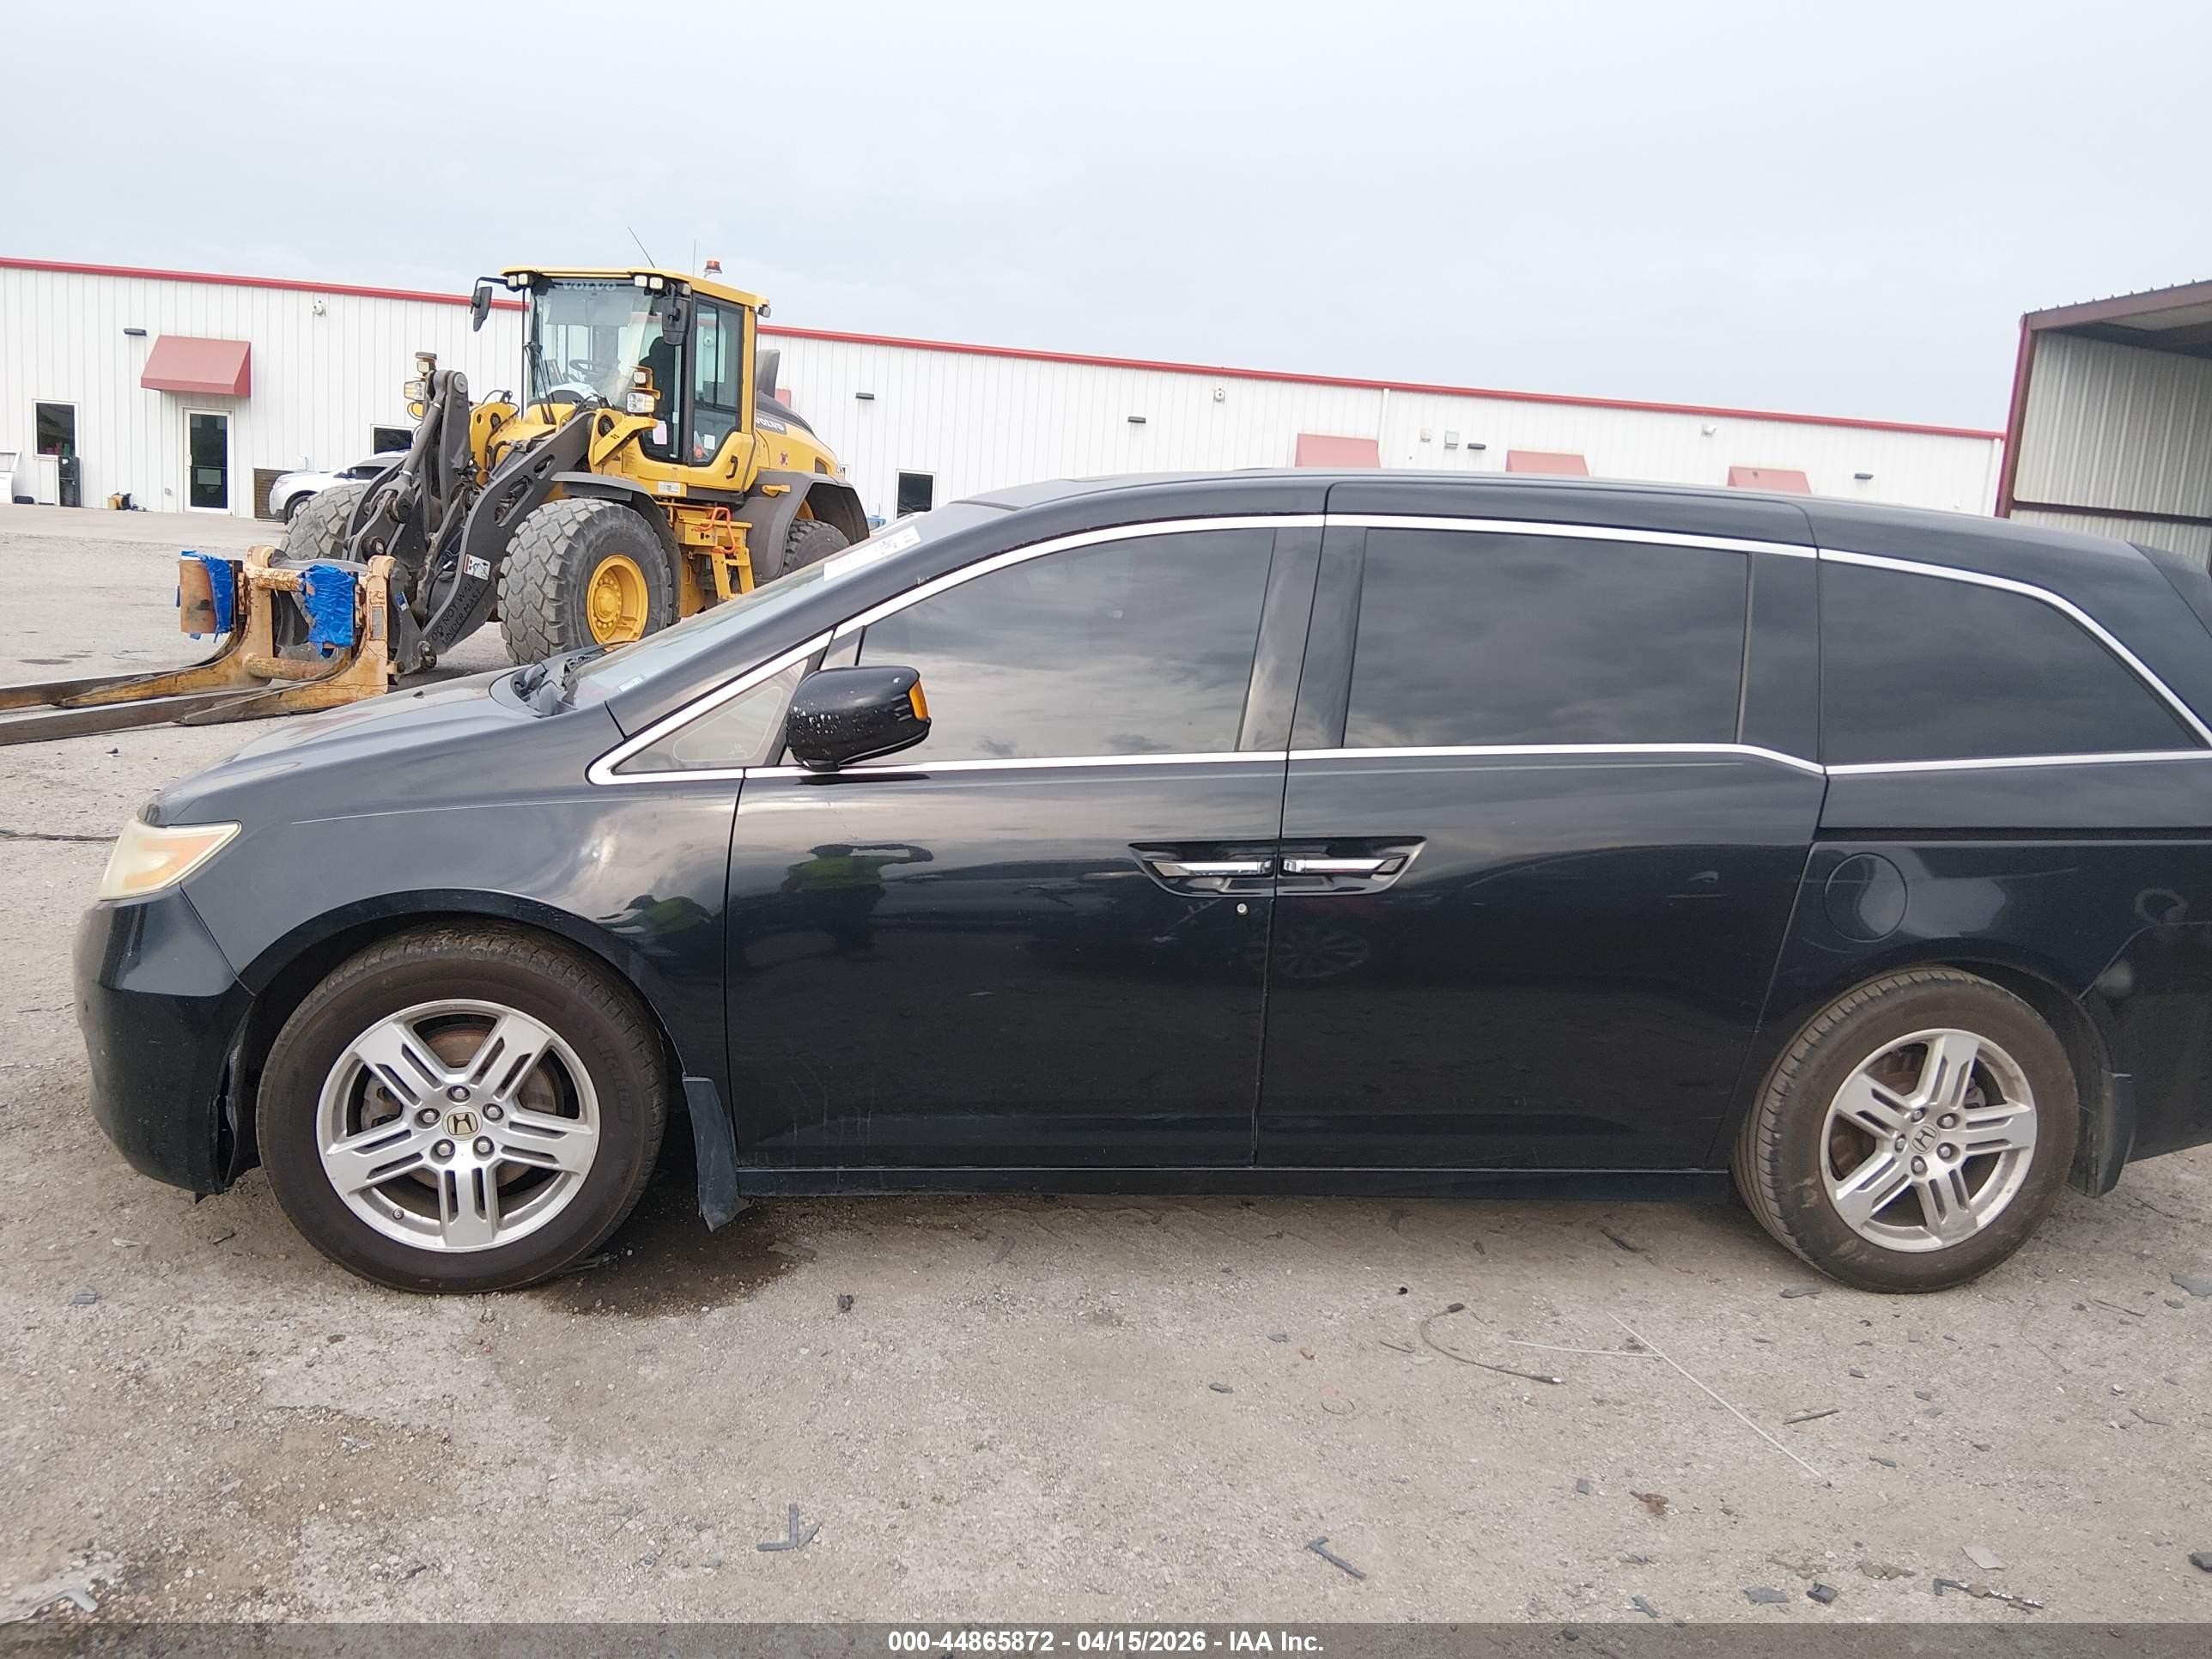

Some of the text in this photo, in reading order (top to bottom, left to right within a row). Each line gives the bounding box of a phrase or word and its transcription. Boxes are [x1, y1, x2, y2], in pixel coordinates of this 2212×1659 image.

[562, 281, 617, 292] VOLVO
[464, 588, 481, 613] MAST
[442, 603, 458, 626] NOT
